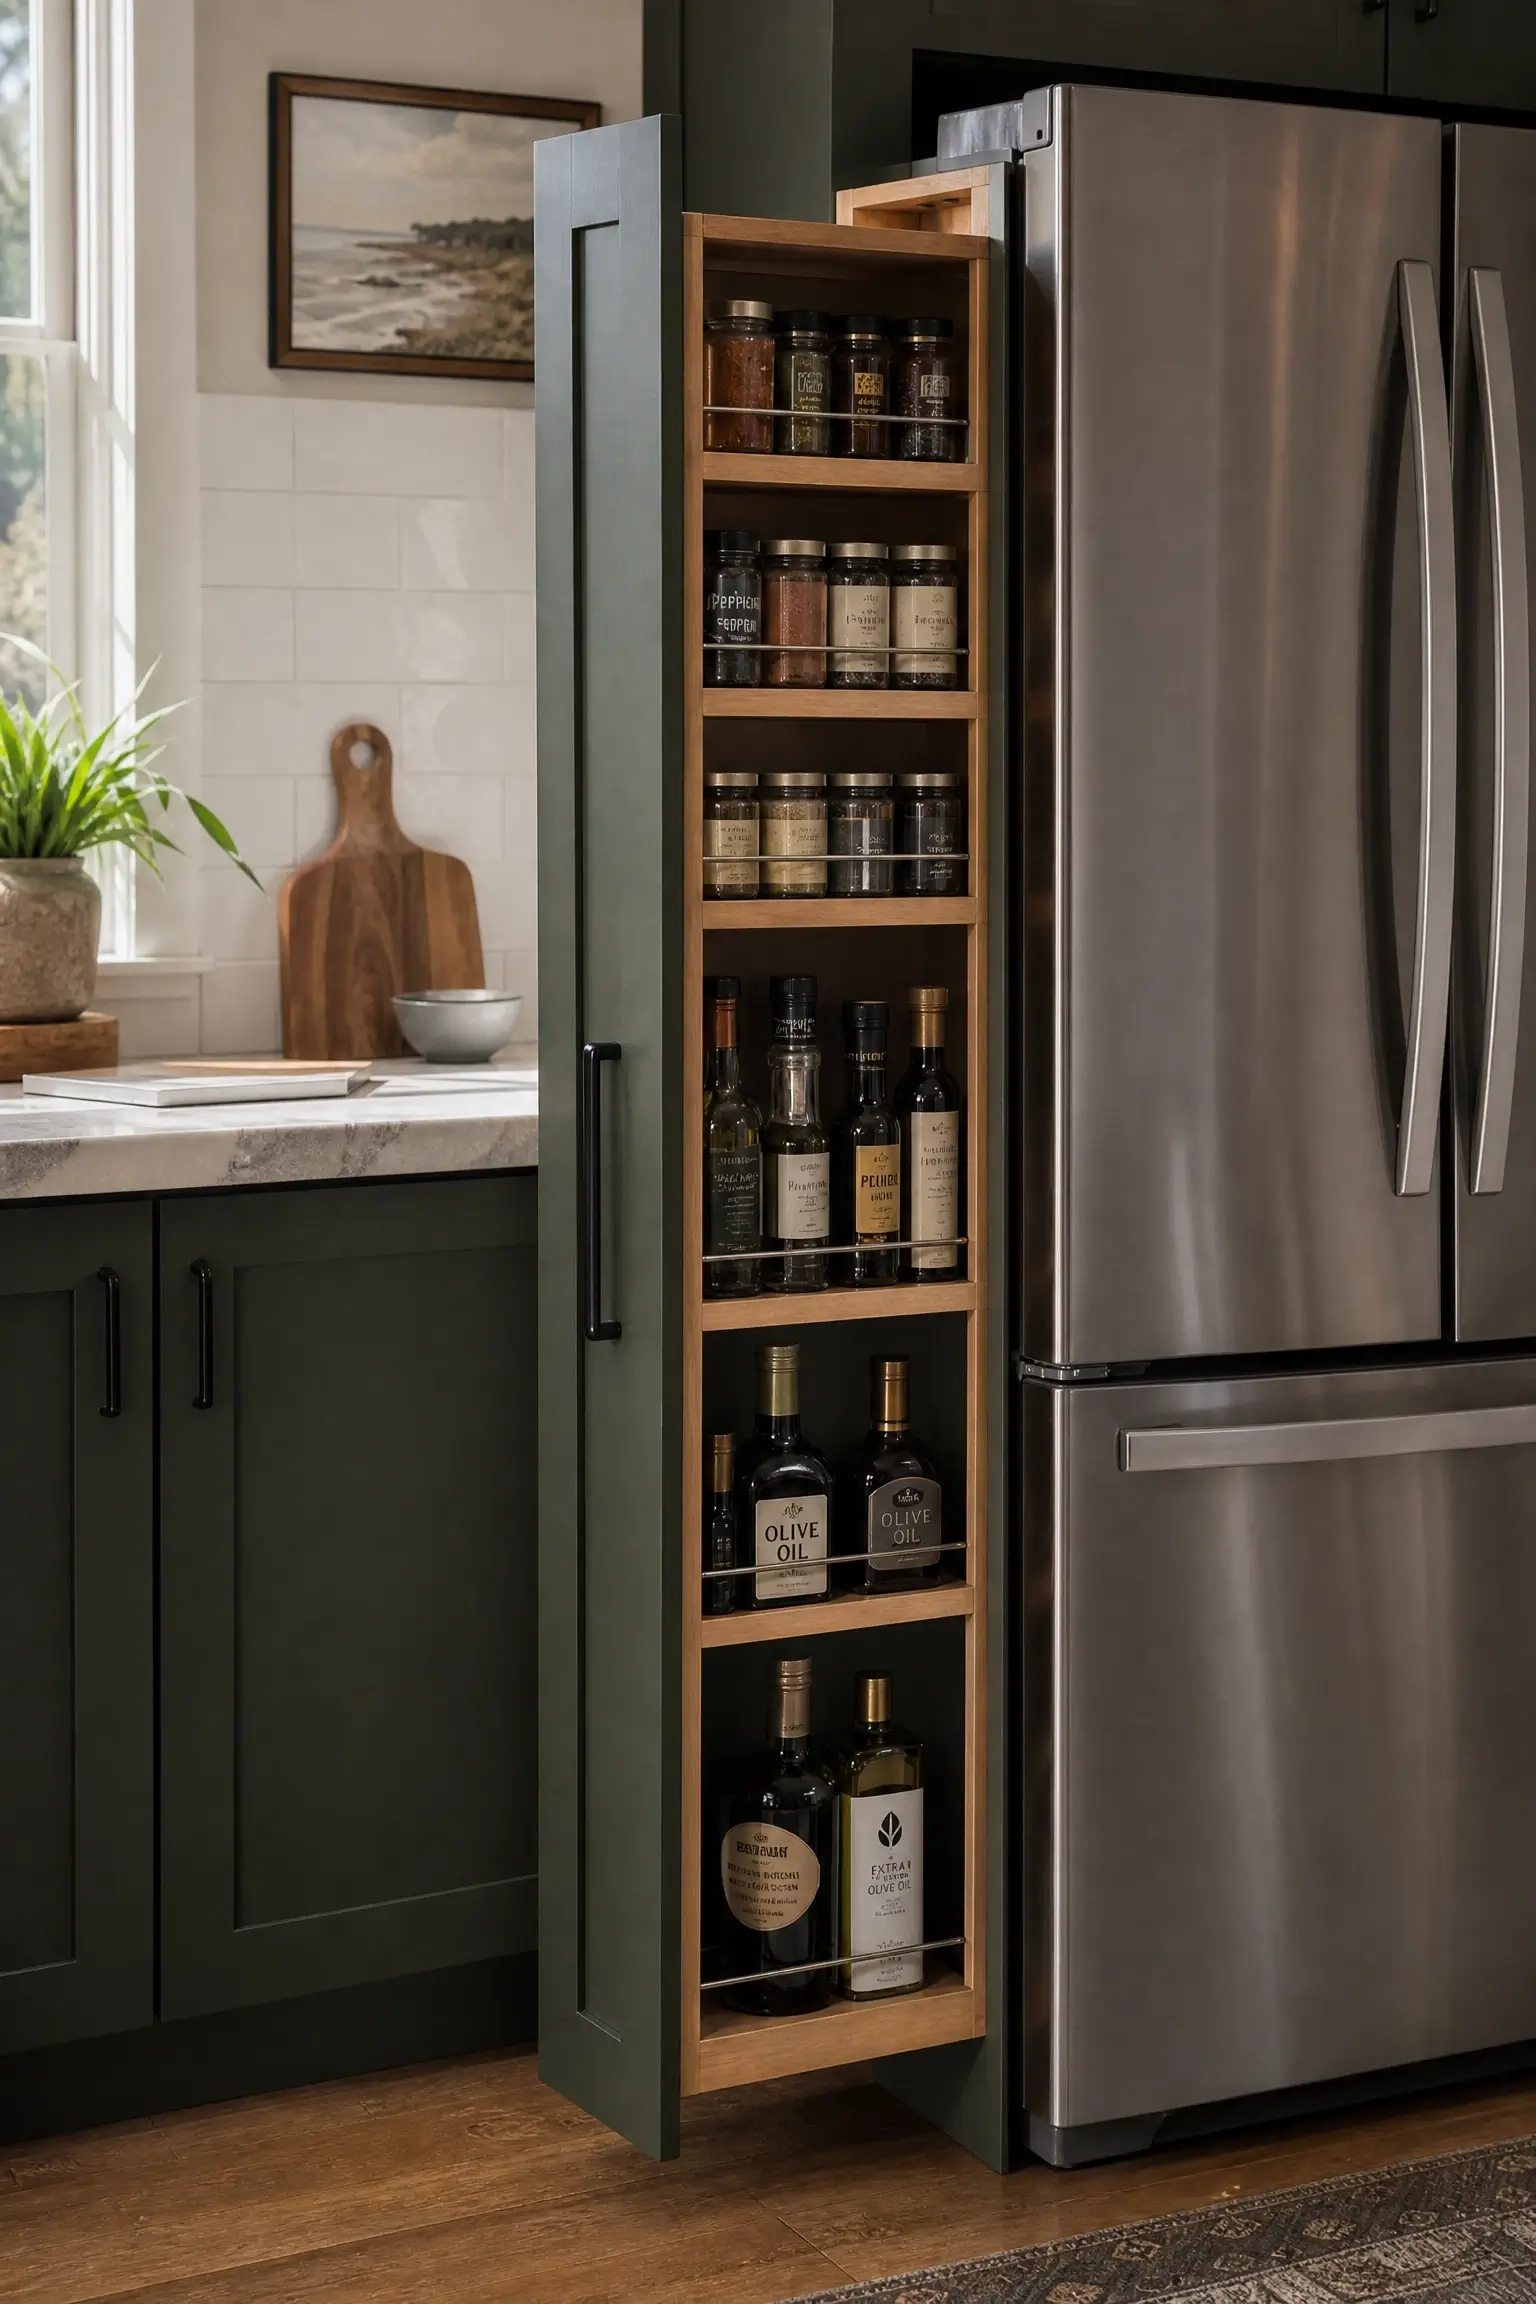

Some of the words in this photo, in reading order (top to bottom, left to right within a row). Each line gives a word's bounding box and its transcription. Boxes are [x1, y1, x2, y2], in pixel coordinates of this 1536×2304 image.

[881, 1508, 931, 1528] OLIVE
[764, 1521, 820, 1543] OLIVE
[893, 1527, 921, 1545] OIL
[777, 1543, 809, 1562] OIL
[871, 1861, 905, 1876] EXTRA
[897, 1879, 912, 1891] OIL
